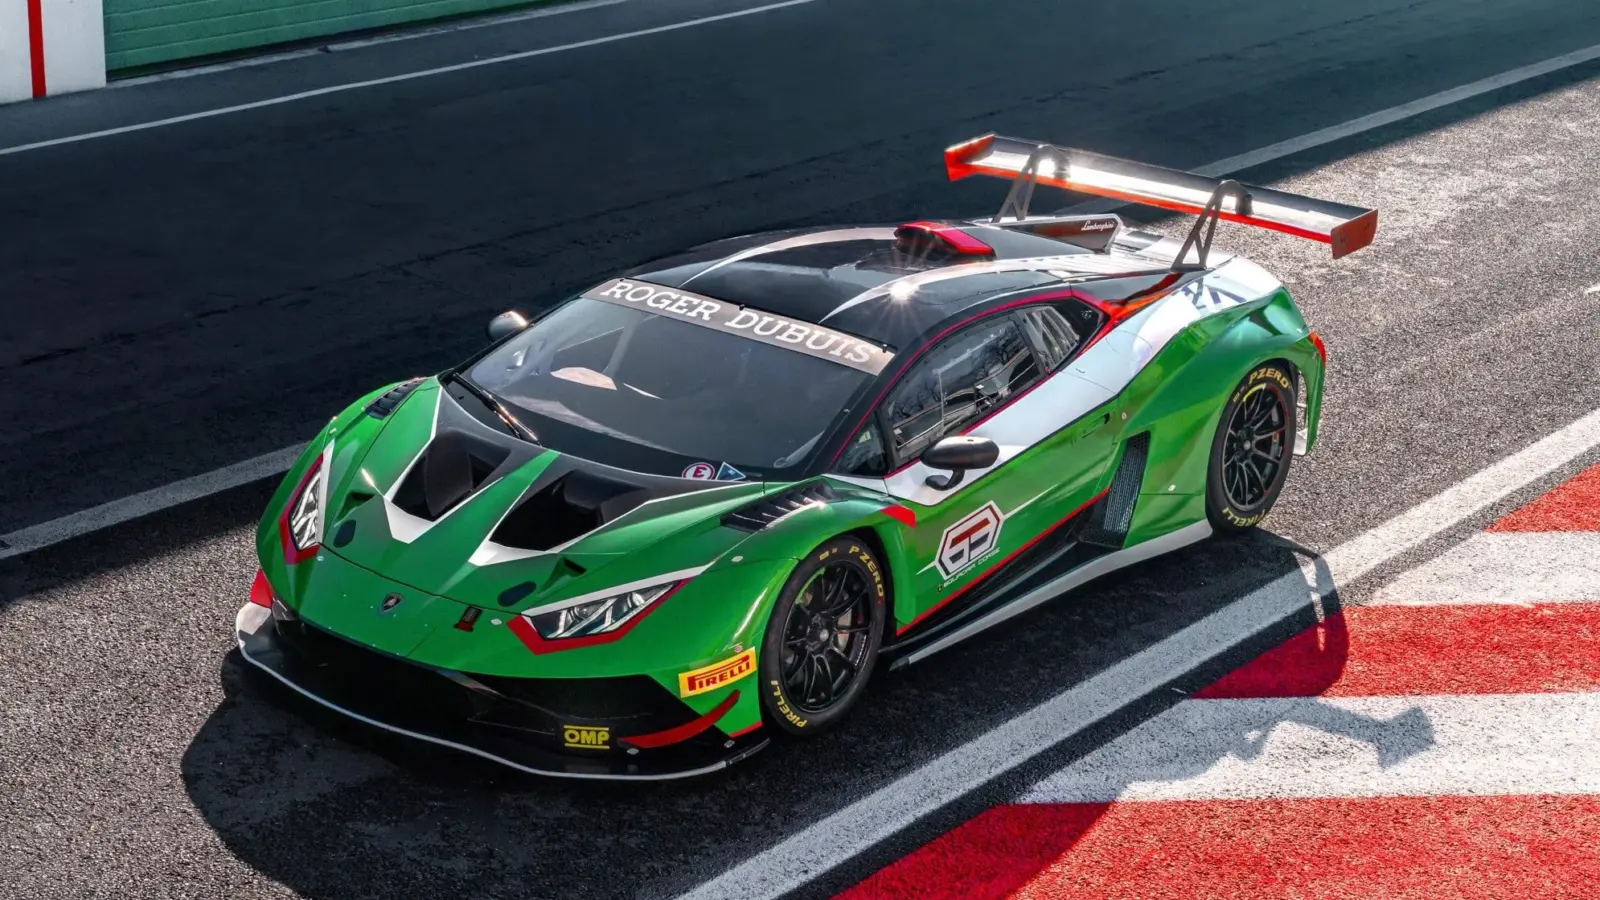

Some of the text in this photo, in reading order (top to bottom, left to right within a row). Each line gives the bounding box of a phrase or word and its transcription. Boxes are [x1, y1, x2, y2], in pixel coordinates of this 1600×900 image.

[599, 281, 876, 364] ROGER DUBUIS
[692, 466, 707, 478] E
[686, 654, 750, 692] PIRELLI
[770, 680, 808, 728] PIRELLI
[564, 728, 610, 746] OMP
